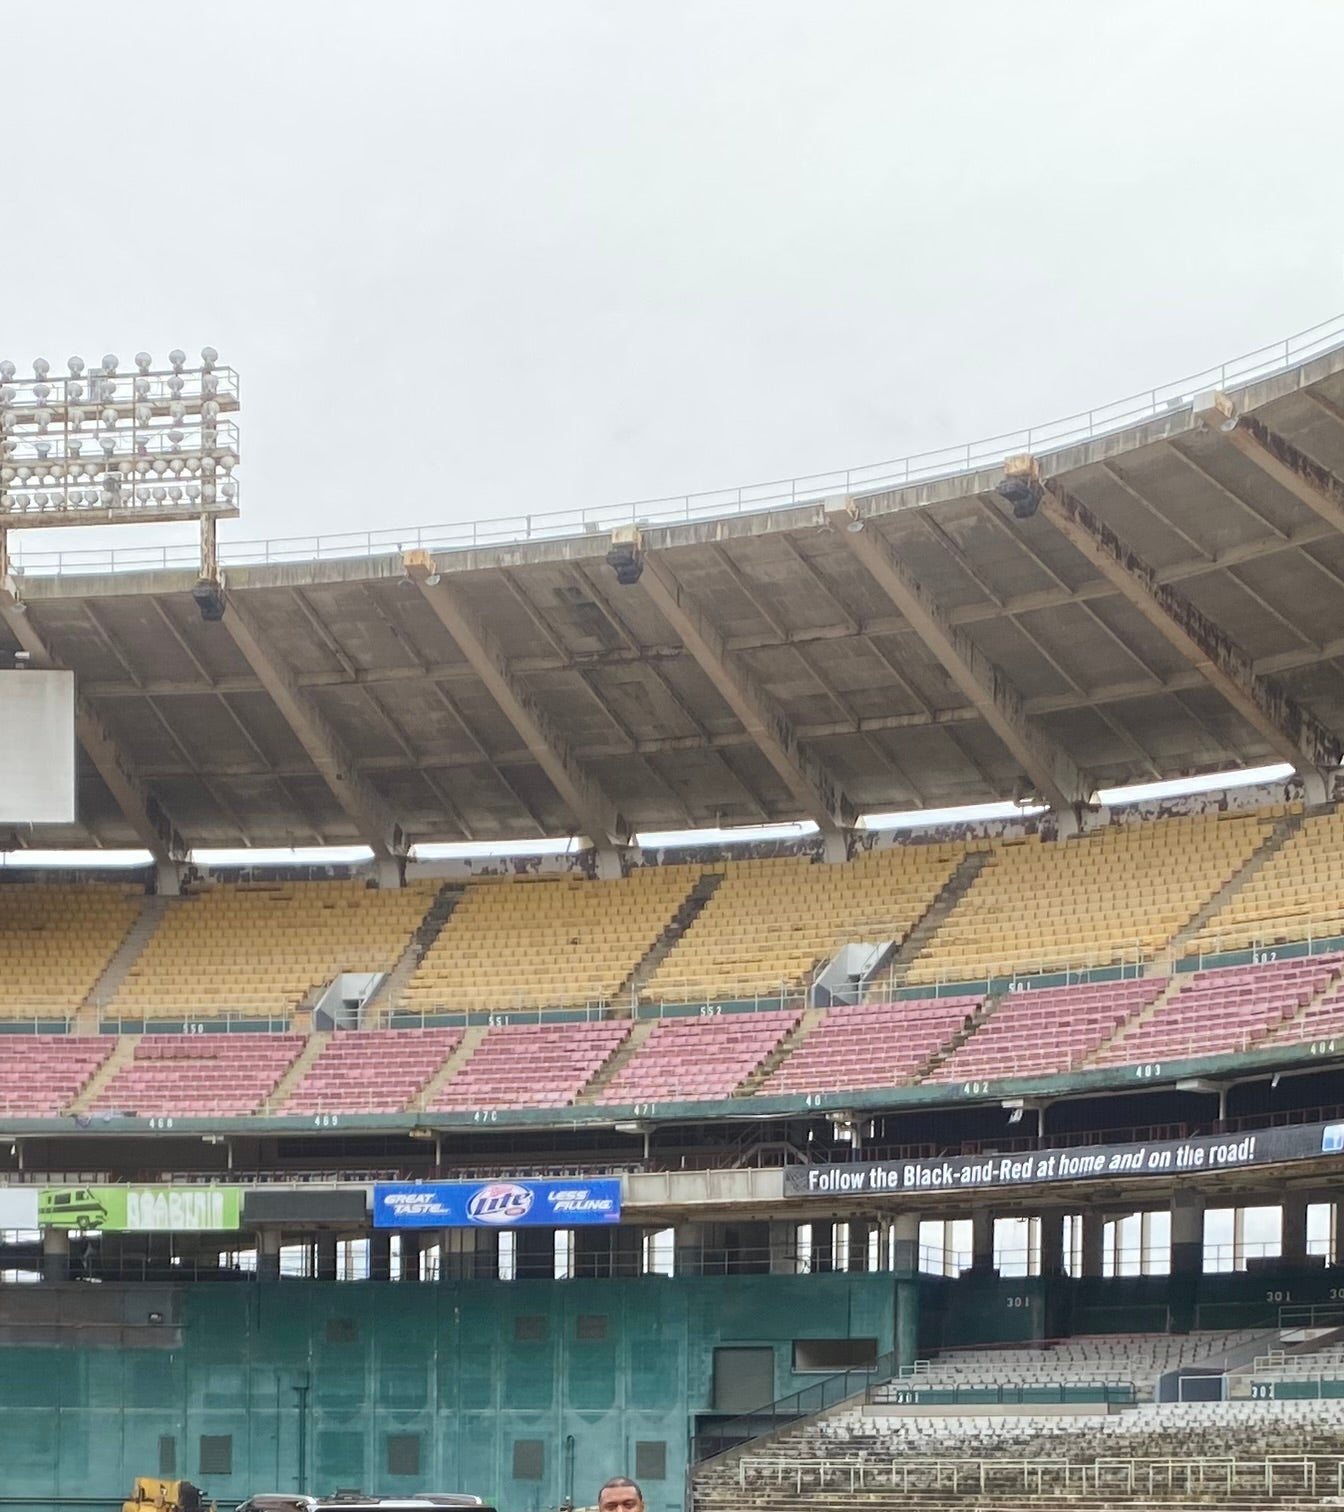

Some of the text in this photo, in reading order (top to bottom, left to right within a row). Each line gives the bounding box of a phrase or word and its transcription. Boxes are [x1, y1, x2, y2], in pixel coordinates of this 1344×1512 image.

[700, 1006, 723, 1017] 552
[1311, 1041, 1335, 1055] 404
[1136, 1064, 1161, 1078] 403
[964, 1082, 989, 1094] 402
[634, 1104, 655, 1116] 471
[149, 1118, 173, 1129] 468
[808, 1137, 1256, 1191] Follow the Black-and-Red at home and on the road!
[384, 1193, 436, 1205] GREAT
[548, 1190, 591, 1202] LESS
[474, 1190, 534, 1216] Lite
[1006, 1296, 1030, 1308] 301
[1266, 1291, 1291, 1302] 301
[897, 1391, 919, 1404] 301
